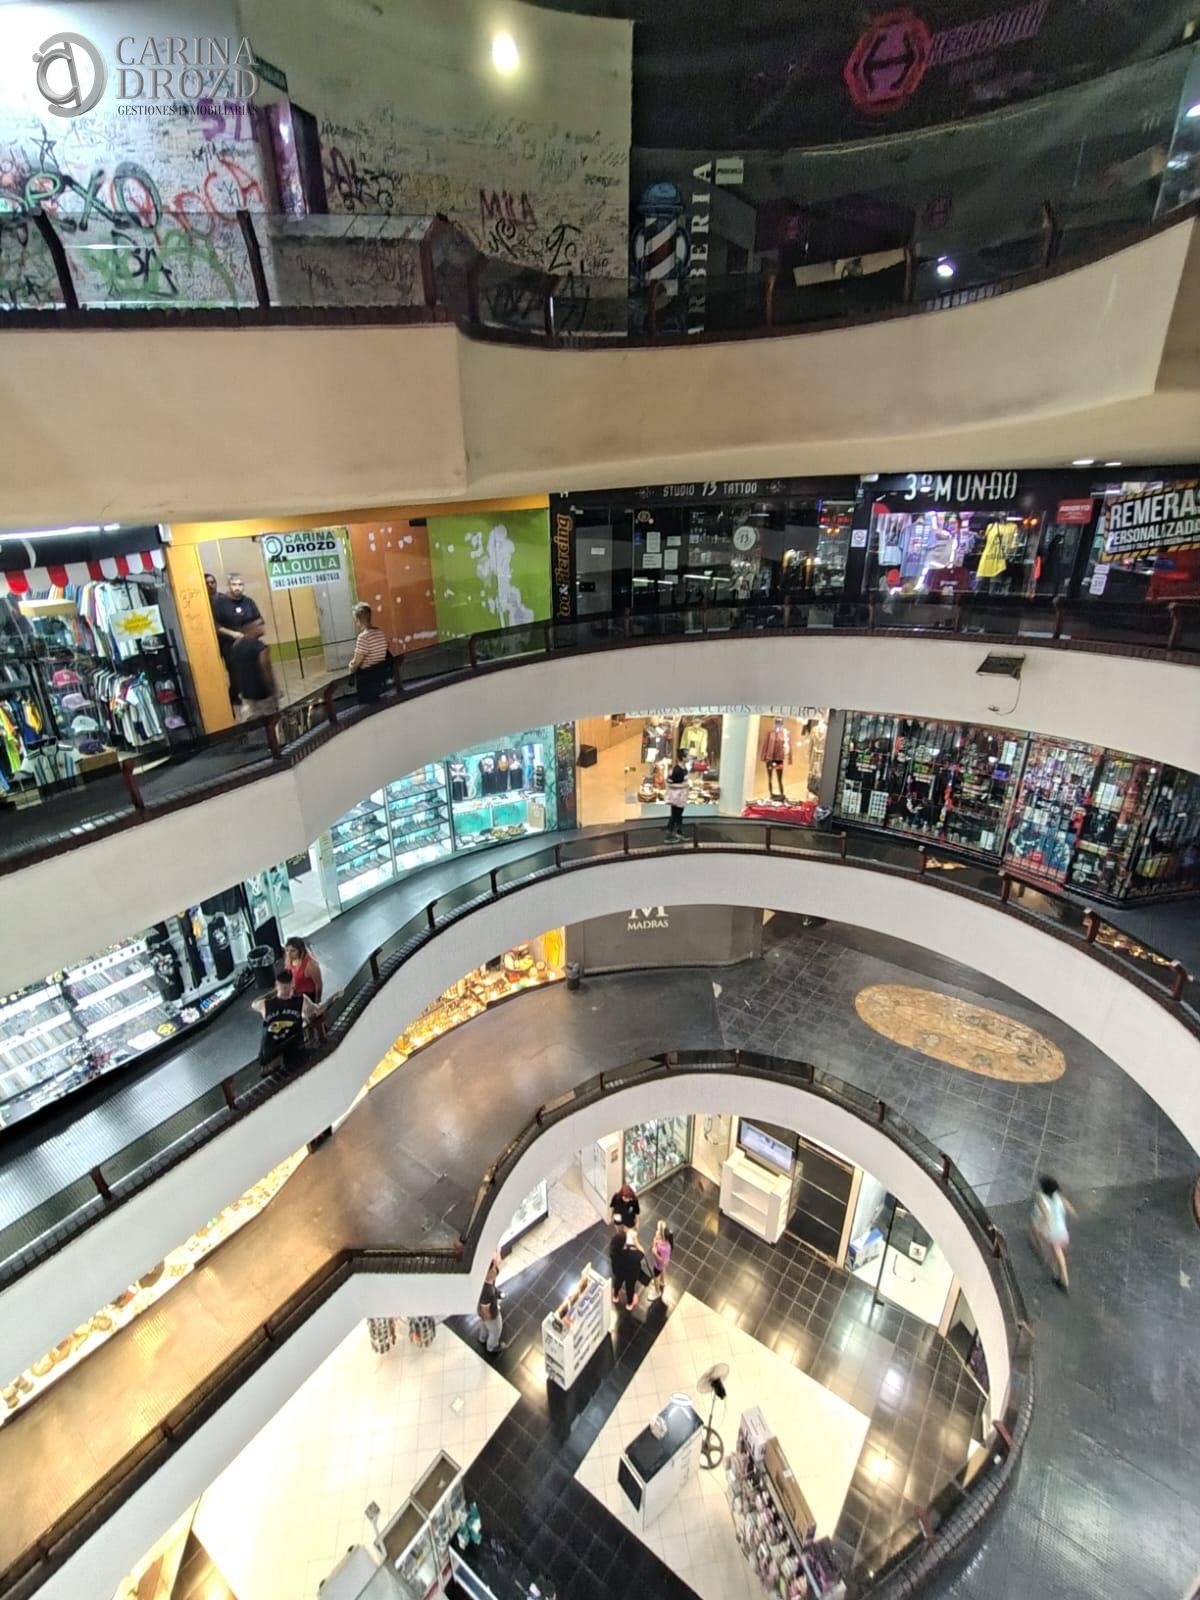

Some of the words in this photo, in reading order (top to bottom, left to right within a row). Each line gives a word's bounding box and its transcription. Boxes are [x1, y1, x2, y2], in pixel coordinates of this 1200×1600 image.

[688, 160, 713, 335] RBERIA
[663, 485, 695, 498] STUDIO
[723, 482, 758, 495] TATTOO
[1109, 489, 1200, 530] REMERA
[284, 531, 335, 544] CARINA
[286, 541, 335, 553] DROZD
[272, 557, 338, 575] ALQUILA
[627, 919, 670, 932] MADRAS
